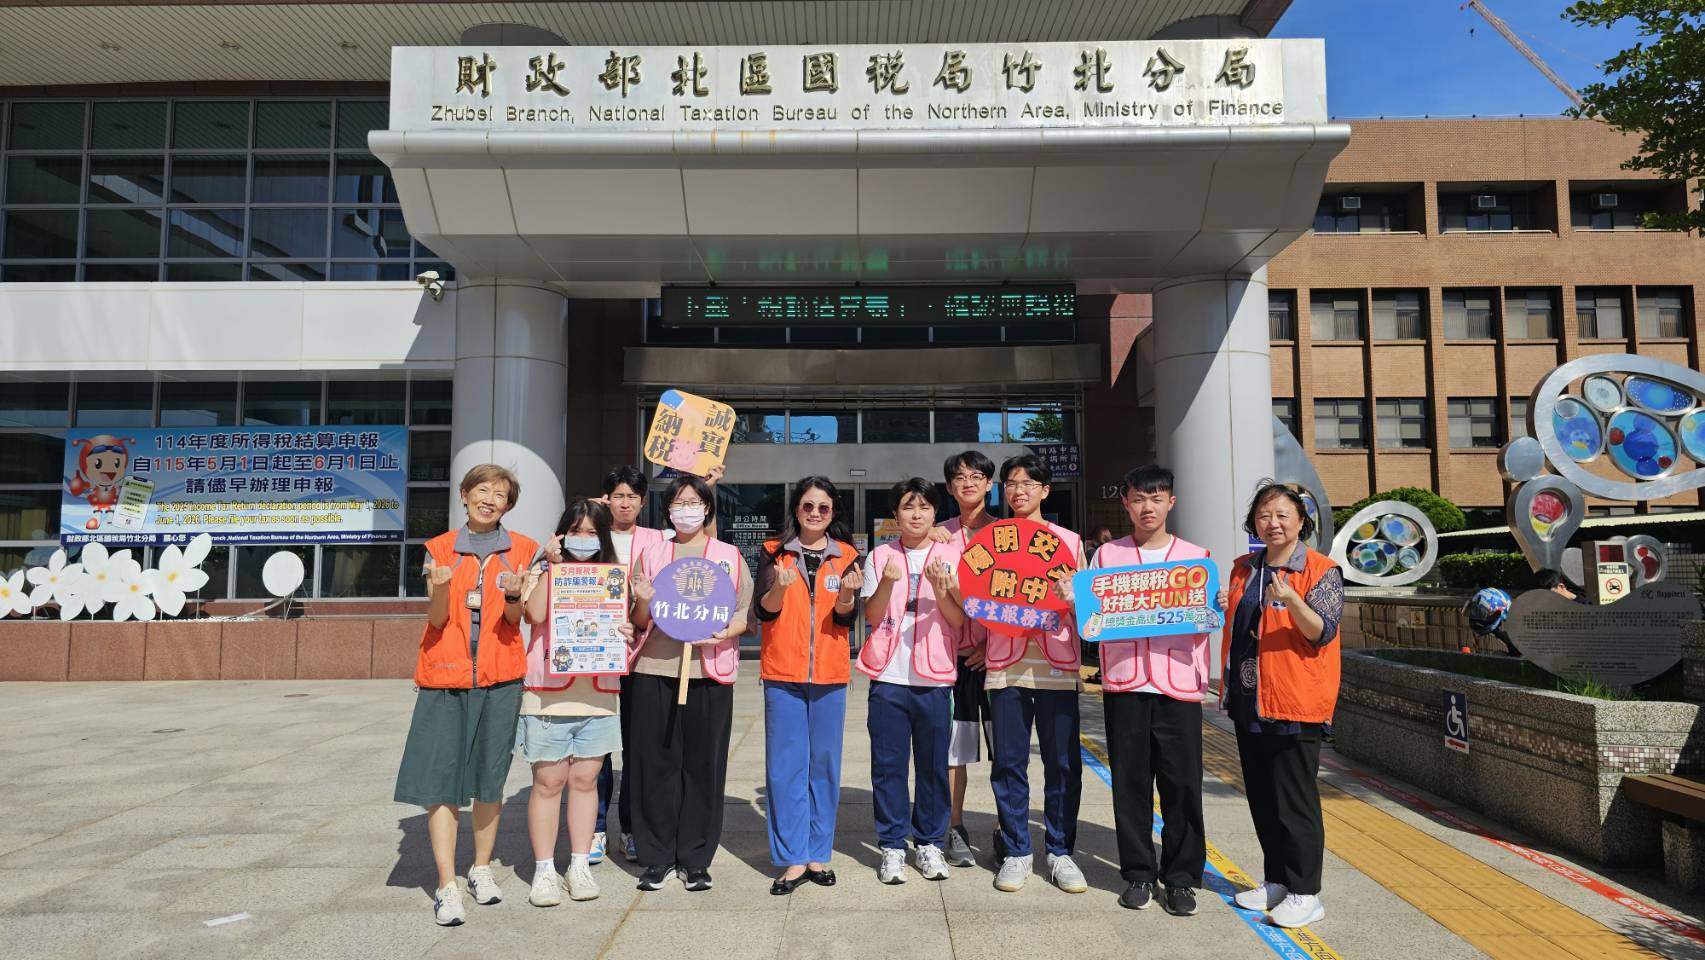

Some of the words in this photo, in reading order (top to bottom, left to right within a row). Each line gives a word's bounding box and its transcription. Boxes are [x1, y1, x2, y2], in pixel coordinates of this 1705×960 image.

[456, 47, 1257, 98] 財政部北區國稅局竹北分局
[431, 105, 493, 121] Zhubei
[506, 105, 574, 124] Branch,
[589, 105, 665, 122] National
[680, 105, 759, 121] Taxation
[773, 105, 837, 121] Bureau
[850, 104, 869, 121] of
[885, 104, 914, 120] the
[928, 103, 1007, 120] Northern
[1021, 103, 1070, 120] Area,
[1084, 101, 1159, 122] Ministry
[1174, 101, 1193, 117] of
[1209, 100, 1284, 117] Finance
[154, 432, 380, 450] 114年度所得稅結算申報
[648, 408, 683, 461] 納稅
[695, 404, 733, 458] 誠實
[132, 453, 399, 473] 自115年5月1日起至6月1日止
[185, 476, 335, 495] 請儘早辦理申報
[156, 501, 169, 511] The
[189, 501, 216, 511] Income
[232, 500, 256, 510] Return
[258, 499, 295, 510] declaration
[298, 500, 320, 512] period
[322, 500, 329, 509] is
[330, 500, 348, 509] from
[349, 500, 364, 511] May
[373, 499, 390, 509] 2026
[391, 500, 400, 509] to
[155, 514, 174, 524] June
[203, 513, 227, 524] Please
[228, 513, 239, 523] file
[240, 515, 257, 525] your
[258, 514, 269, 523] tax
[271, 515, 281, 523] as
[282, 515, 298, 523] soon
[311, 513, 343, 525] possible.
[990, 568, 1049, 604] 附中
[1092, 565, 1209, 597] 手機報稅GO
[653, 600, 729, 623] 竹北分局
[1102, 588, 1207, 612] 好禮大FUN送
[964, 597, 1059, 631] 學生服務隊
